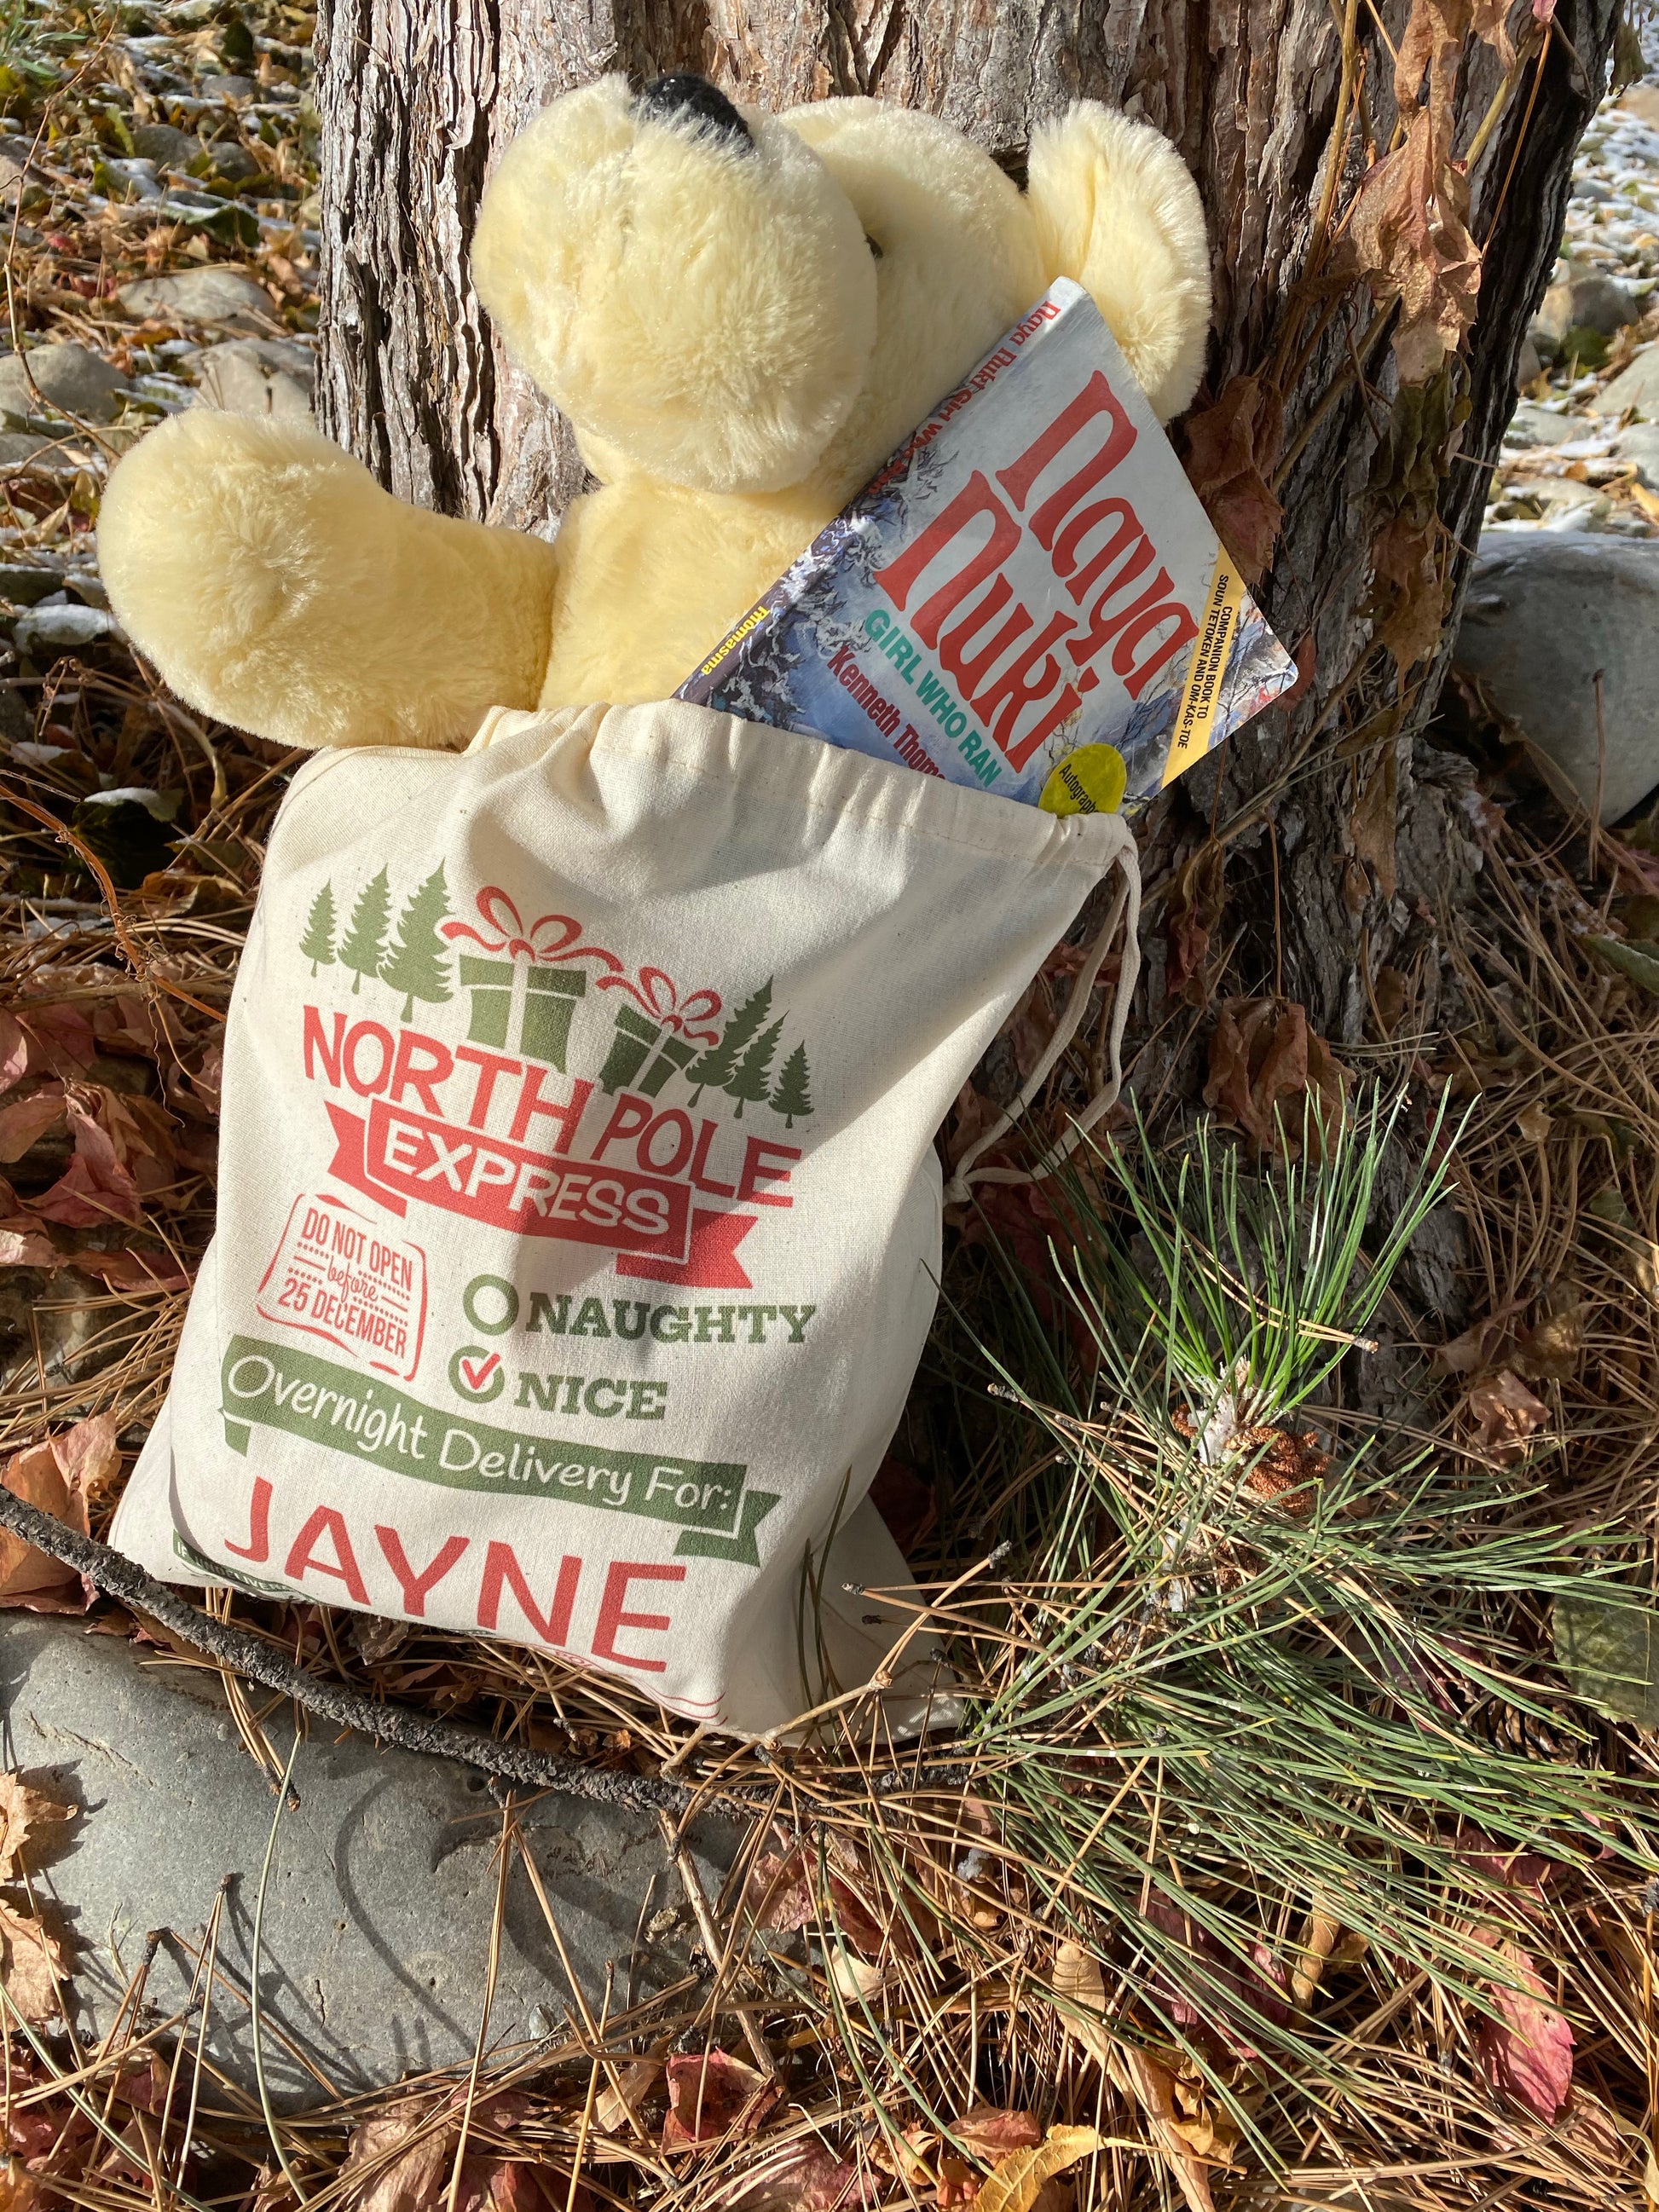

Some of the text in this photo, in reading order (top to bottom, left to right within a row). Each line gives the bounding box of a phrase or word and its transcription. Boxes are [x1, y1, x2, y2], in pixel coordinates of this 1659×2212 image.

[1009, 300, 1061, 346] Naya
[939, 389, 973, 421] Girl
[970, 347, 1017, 390] Nuki
[902, 423, 943, 459] Who
[995, 369, 1199, 701] Naya
[701, 605, 771, 675] Thomasma
[873, 470, 1100, 773] Nuki
[1177, 574, 1229, 749] SOUN TETOKEN AND OM-KAS-TOE
[1197, 606, 1233, 719] COMPANION BOOK TO
[827, 644, 945, 779] Kenneth Thom
[864, 609, 1003, 788] GIRL WHO RAN
[1058, 763, 1100, 814] Autograph
[303, 1004, 802, 1208] NORTH POLE
[384, 1118, 670, 1235] EXPRESS
[301, 1207, 413, 1292] DO NOT OPEN
[327, 1255, 379, 1304] before
[278, 1277, 408, 1360] 25 DECEMBER
[524, 1291, 817, 1344] NAUGHTY
[228, 1354, 732, 1510] Overnight Delivery For:
[513, 1372, 668, 1421] NICE
[225, 1476, 686, 1672] JAYNE
